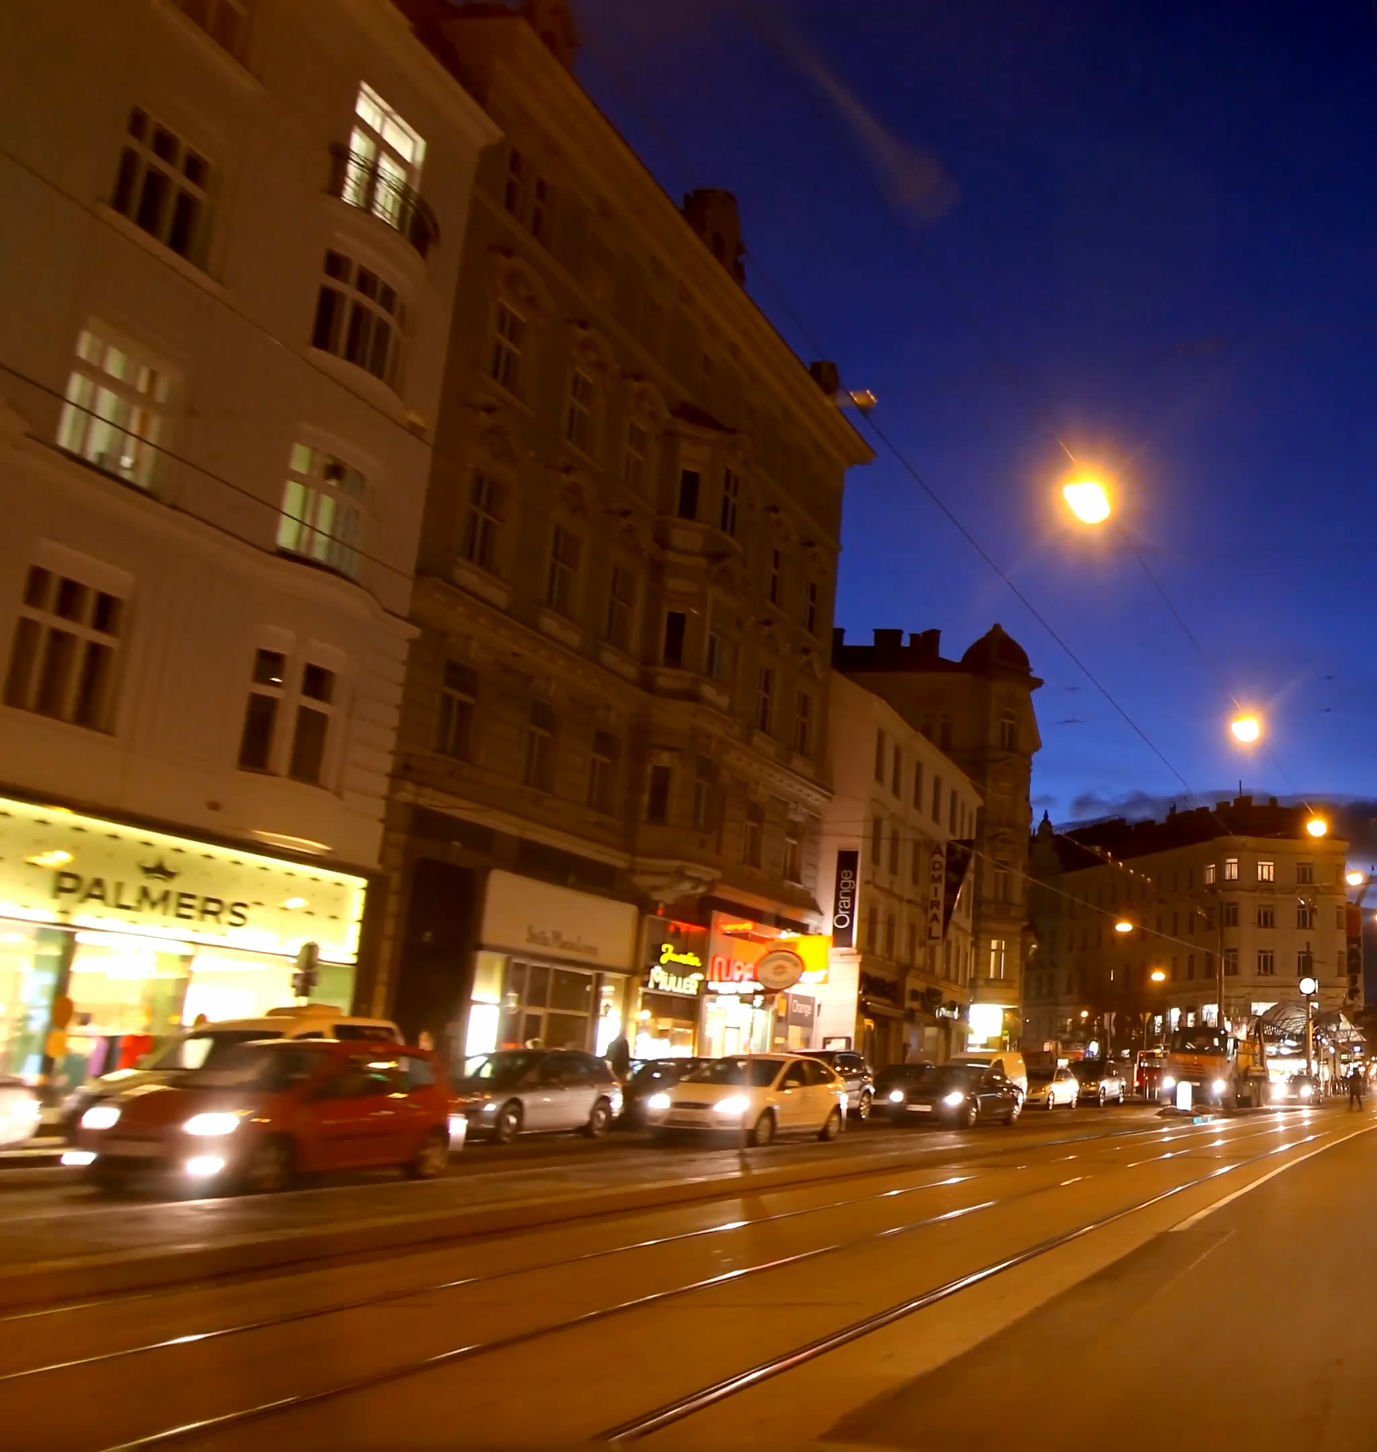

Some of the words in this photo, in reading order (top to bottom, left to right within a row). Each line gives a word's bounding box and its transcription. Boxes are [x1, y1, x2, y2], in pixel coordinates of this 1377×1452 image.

[52, 871, 249, 928] PALMERS
[833, 869, 856, 929] Orange
[928, 844, 944, 940] ADMIRAL
